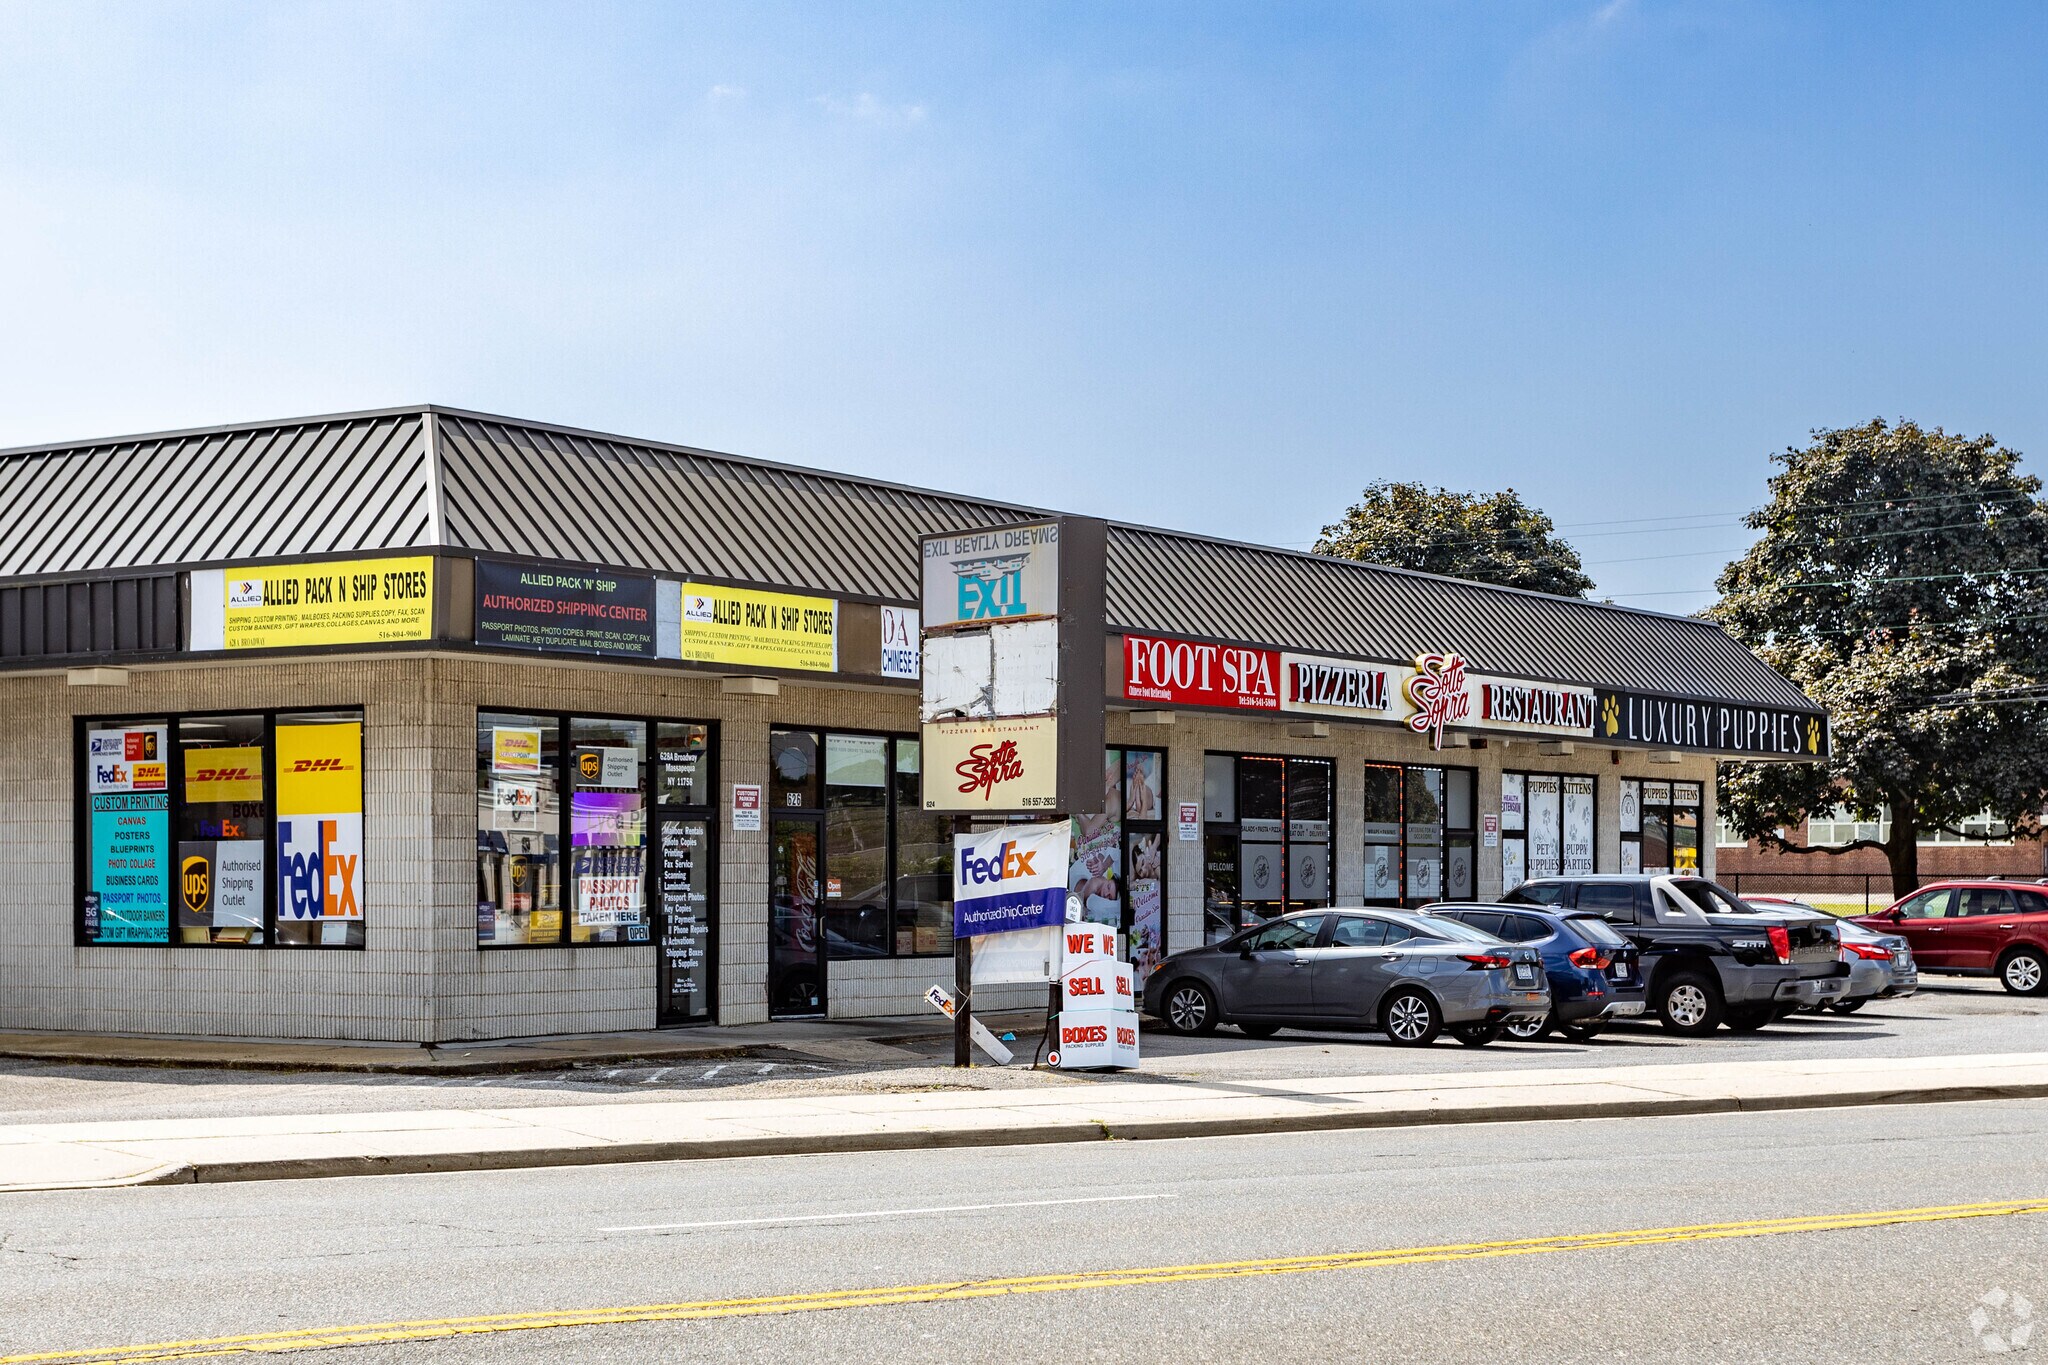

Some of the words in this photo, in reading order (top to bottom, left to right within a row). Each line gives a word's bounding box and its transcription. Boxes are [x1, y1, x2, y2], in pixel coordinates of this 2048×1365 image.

[521, 573, 553, 586] ALLIED
[556, 578, 581, 588] PACK
[596, 580, 616, 592] SHIP
[263, 579, 298, 606] ALLIED
[305, 577, 332, 604] PACK
[339, 576, 346, 602] N
[353, 574, 377, 601] SHIP
[384, 571, 426, 600] STORES
[483, 594, 554, 613] AUTHORIZED
[557, 601, 606, 617] SHIPPING
[609, 606, 647, 621] CENTER
[713, 600, 740, 625] ALLIED
[746, 606, 766, 628] PACK
[771, 608, 776, 630] N
[782, 608, 799, 632] SHIP
[804, 610, 832, 635] STORES
[482, 622, 513, 631] PASSPORT
[502, 634, 530, 642] LAMINATE
[882, 649, 911, 673] CHINESE
[1128, 638, 1216, 691] FOOT
[1222, 649, 1275, 696] SPA
[1297, 663, 1392, 711] PIZZERIA
[1489, 684, 1598, 729] RESTAURANT
[1629, 697, 1712, 746] LUXURY
[1720, 708, 1801, 754] PUPPIES
[505, 739, 528, 747] DHL
[674, 753, 697, 763] Broadway
[970, 740, 1017, 769] Sotto
[294, 759, 343, 772] DHL
[582, 762, 597, 774] ups
[666, 764, 695, 772] Massapequa
[98, 765, 127, 783] FedEx
[138, 768, 160, 777] DHL
[197, 768, 251, 781] DHL
[956, 756, 1024, 801] Sopra
[1529, 781, 1556, 793] PUPPIES
[1564, 783, 1591, 794] KITTENS
[498, 788, 532, 805] FedEx
[1644, 788, 1667, 799] PUPPIES
[1674, 790, 1697, 800] KITTENS
[94, 797, 128, 809] CUSTOM
[131, 796, 168, 809] PRINTING
[787, 794, 801, 806] 626
[1022, 798, 1032, 806] 516
[1502, 802, 1520, 812] EXTENSION
[118, 817, 146, 825] CANVAS
[200, 820, 240, 837] FedEx
[681, 838, 697, 847] Copies
[664, 849, 683, 858] Printing
[1537, 844, 1549, 854] PET
[1567, 844, 1588, 854] PUPPY
[109, 859, 127, 868] PHOTO
[130, 859, 155, 868] COLLAGE
[222, 861, 260, 871] Authorised
[962, 840, 1036, 885] FedEx
[1208, 862, 1234, 871] WELCOME
[1564, 859, 1591, 870] PARTIES
[278, 820, 357, 919] FedEx
[512, 866, 526, 882] ups
[106, 876, 136, 885] BUSINESS
[138, 876, 158, 885] CARDS
[664, 871, 686, 880] Scanning
[185, 875, 206, 902] ups
[222, 877, 253, 890] Shipping
[580, 879, 638, 894] PASSSPORT
[664, 882, 690, 891] Laminating
[828, 881, 841, 890] Open
[103, 893, 134, 903] PASSPORT
[137, 893, 161, 903] PHOTOS
[222, 895, 245, 905] Outlet
[664, 893, 686, 902] Passport
[590, 896, 629, 911] PHOTOS
[664, 904, 673, 914] Key
[676, 904, 692, 913] Copies
[86, 908, 96, 917] 5G
[581, 913, 611, 922] TAKEN
[615, 912, 637, 921] HERE
[674, 916, 696, 925] Payment
[630, 927, 648, 939] OPEN
[690, 925, 708, 934] Repairs
[668, 937, 694, 945] Activations
[1067, 934, 1093, 953] WE
[1103, 934, 1113, 956] WE
[666, 949, 687, 958] Shipping
[678, 960, 698, 968] Supplies
[1069, 977, 1104, 996] SELL
[1116, 976, 1131, 996] SELL
[930, 989, 955, 1015] FedEx
[1062, 1026, 1107, 1043] BOXES
[1117, 1027, 1135, 1045] BOXES
